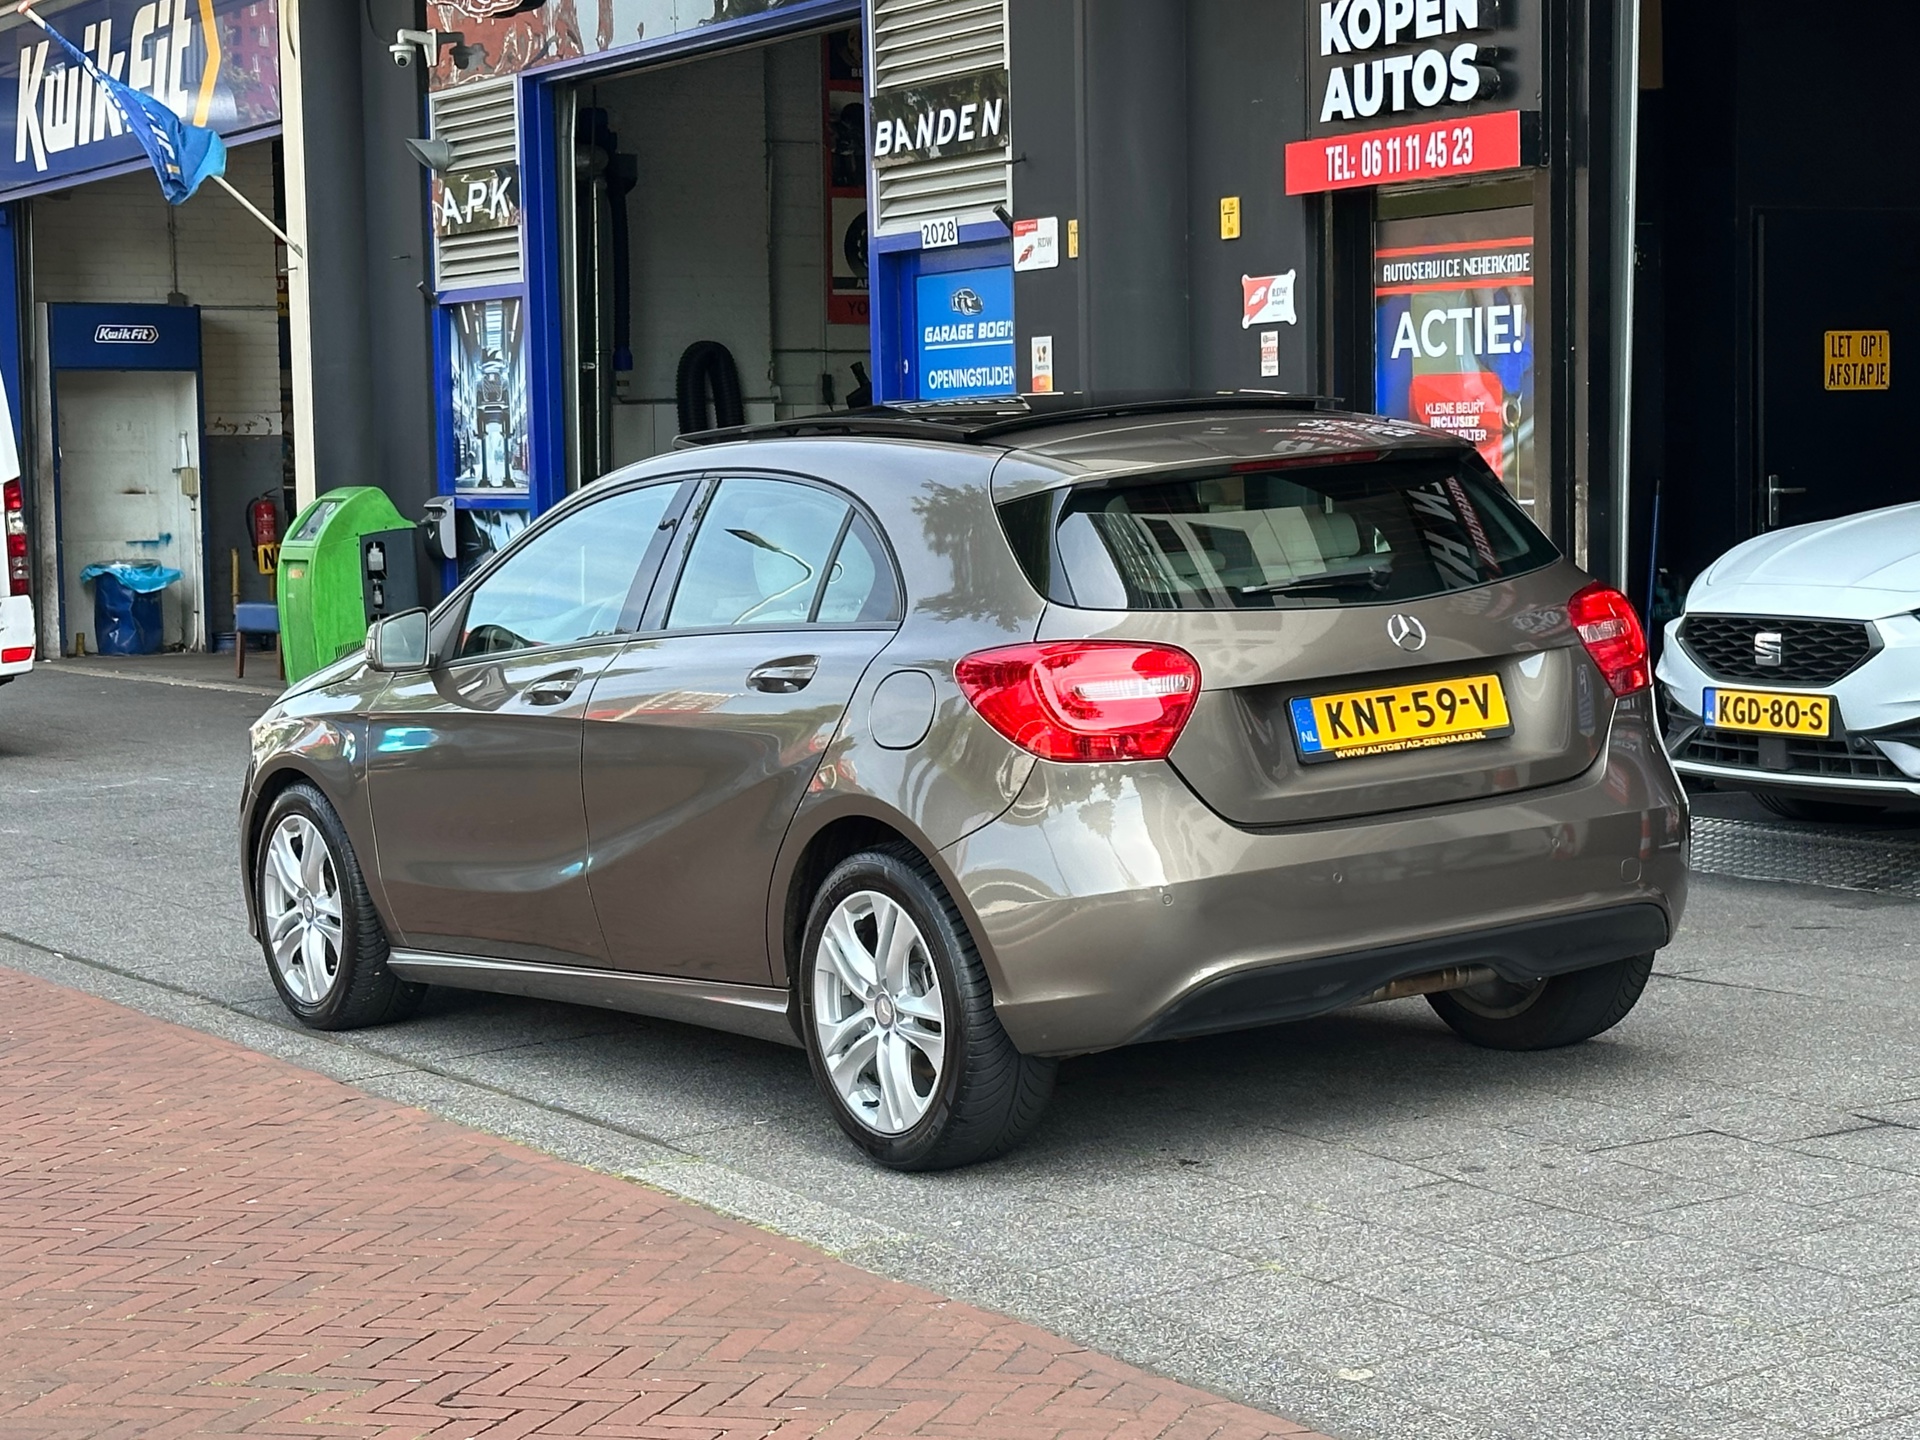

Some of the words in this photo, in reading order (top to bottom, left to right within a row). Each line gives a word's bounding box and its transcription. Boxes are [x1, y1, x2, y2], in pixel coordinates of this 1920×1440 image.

[1320, 0, 1479, 56] KOPEN
[1319, 43, 1480, 122] AUTOS
[874, 98, 1002, 157] BANDEN
[1325, 144, 1356, 182] TEL:
[1361, 139, 1382, 177] 06
[1386, 136, 1401, 174] 11
[1405, 133, 1420, 171] 11
[1425, 130, 1448, 169] 45
[1452, 126, 1474, 166] 23
[441, 176, 512, 227] APK
[922, 220, 956, 245] 2028
[1383, 258, 1461, 282] AUTOSERVICE
[1463, 252, 1531, 276] NEHERKADE
[924, 323, 975, 343] GARAGE
[1390, 303, 1523, 359] ACTIE!
[1831, 334, 1852, 358] LET
[1861, 334, 1883, 357] OP!
[1828, 362, 1887, 386] AFSTAPJE
[1425, 402, 1455, 415] KLEINE
[1455, 401, 1485, 414] BEURT
[1430, 415, 1480, 428] INCLUSIEF
[1325, 682, 1489, 740] KNT-59-V
[1719, 695, 1823, 730] KGD-80-S
[1301, 730, 1318, 743] NL
